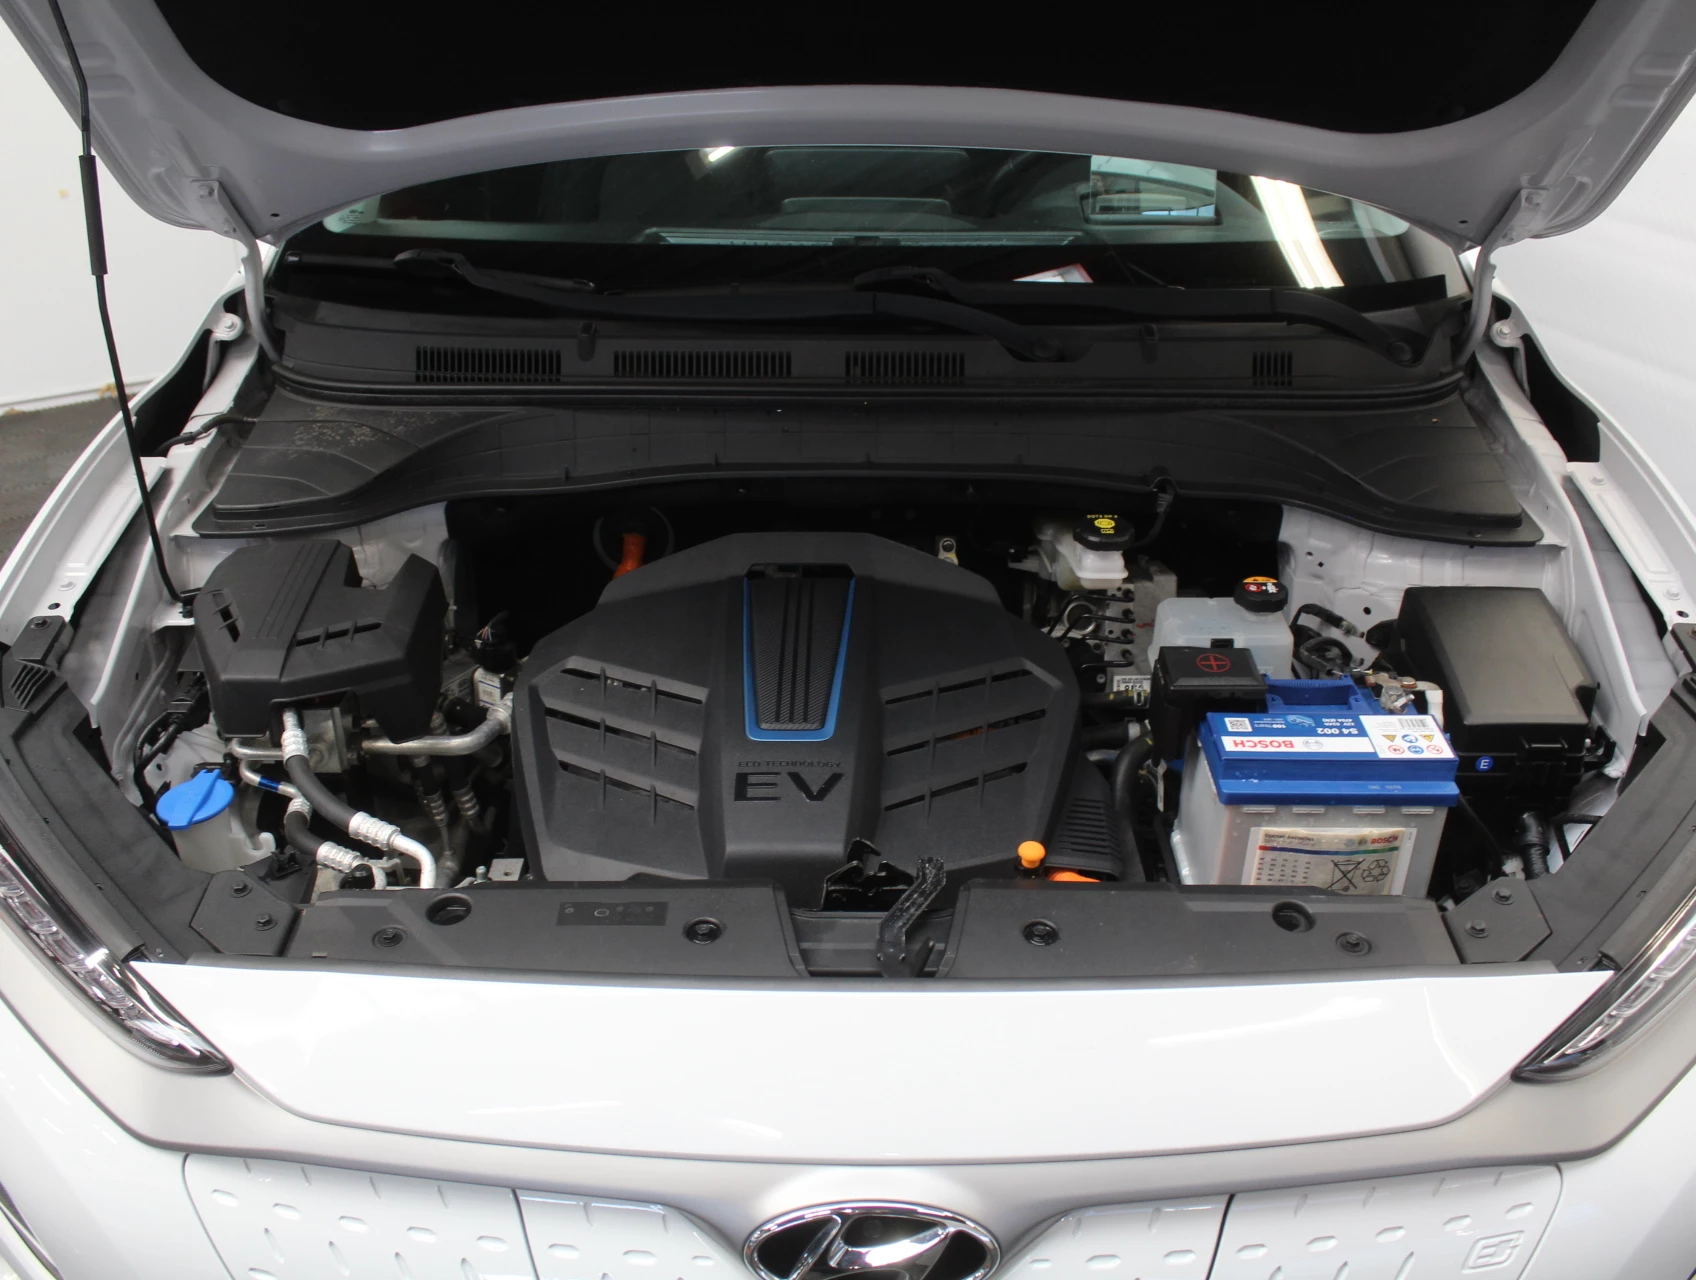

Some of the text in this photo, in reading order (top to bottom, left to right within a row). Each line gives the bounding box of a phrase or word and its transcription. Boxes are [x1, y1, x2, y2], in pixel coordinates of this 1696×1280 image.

[1232, 739, 1295, 749] BOSCH
[738, 760, 842, 768] ECO TECHNOLOGY
[1480, 759, 1490, 769] E
[734, 771, 845, 802] EV
[1371, 835, 1399, 845] BOSCH
